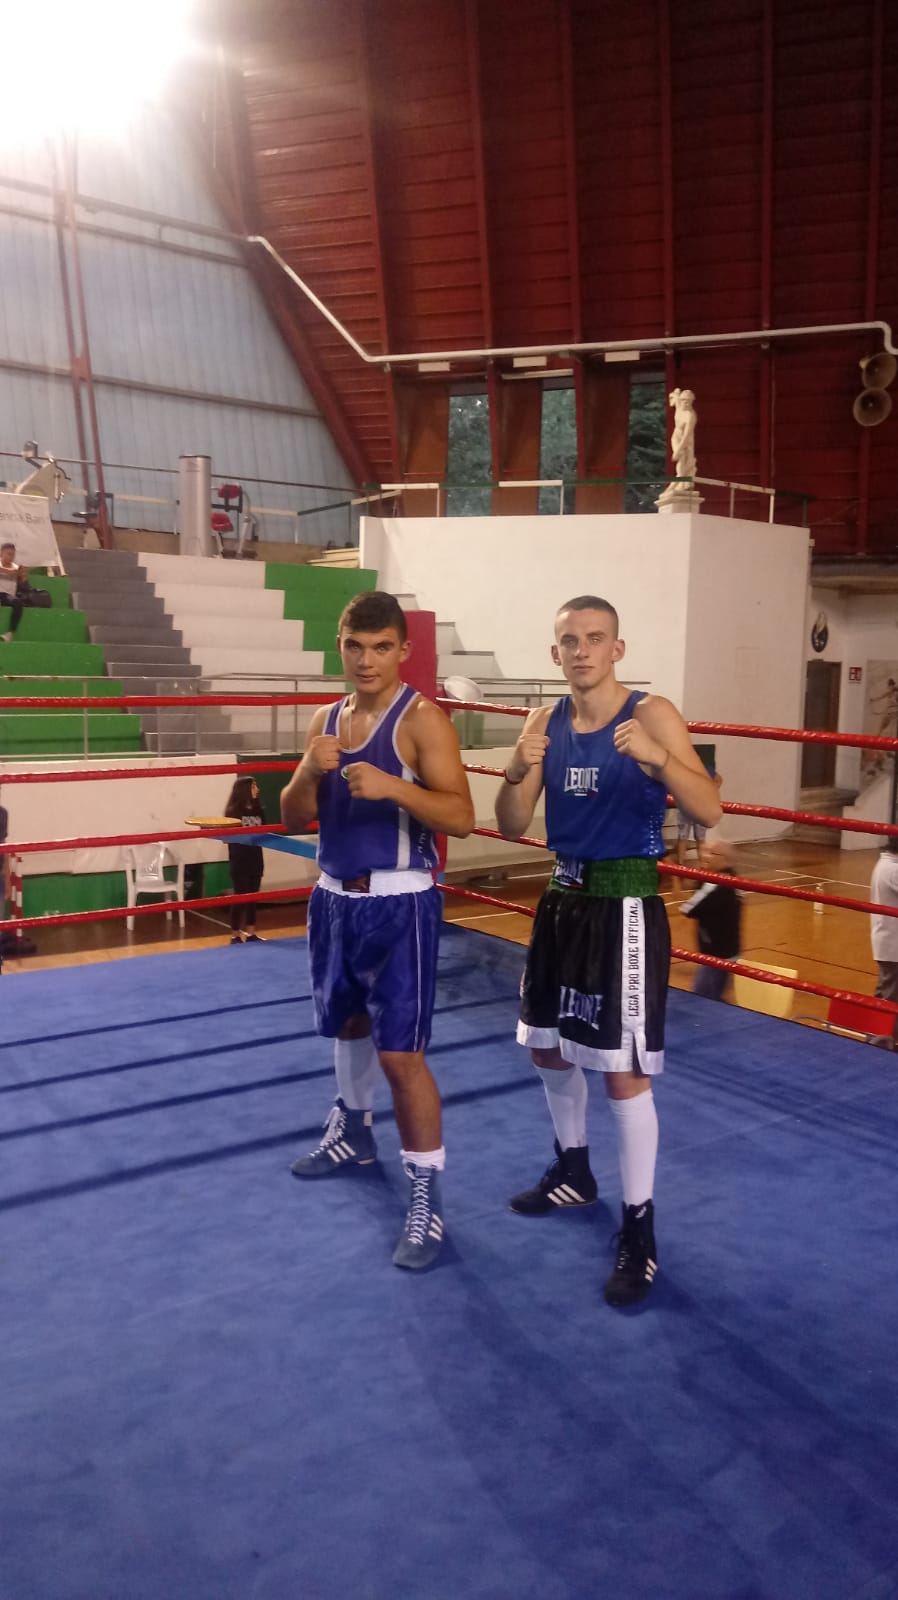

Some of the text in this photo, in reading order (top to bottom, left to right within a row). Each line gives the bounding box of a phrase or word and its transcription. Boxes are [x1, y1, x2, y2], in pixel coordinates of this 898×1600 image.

[564, 767, 600, 793] LEONE
[628, 900, 640, 1017] LEGA PRO BOXE OFFICIAL
[558, 985, 603, 1031] LEONE
